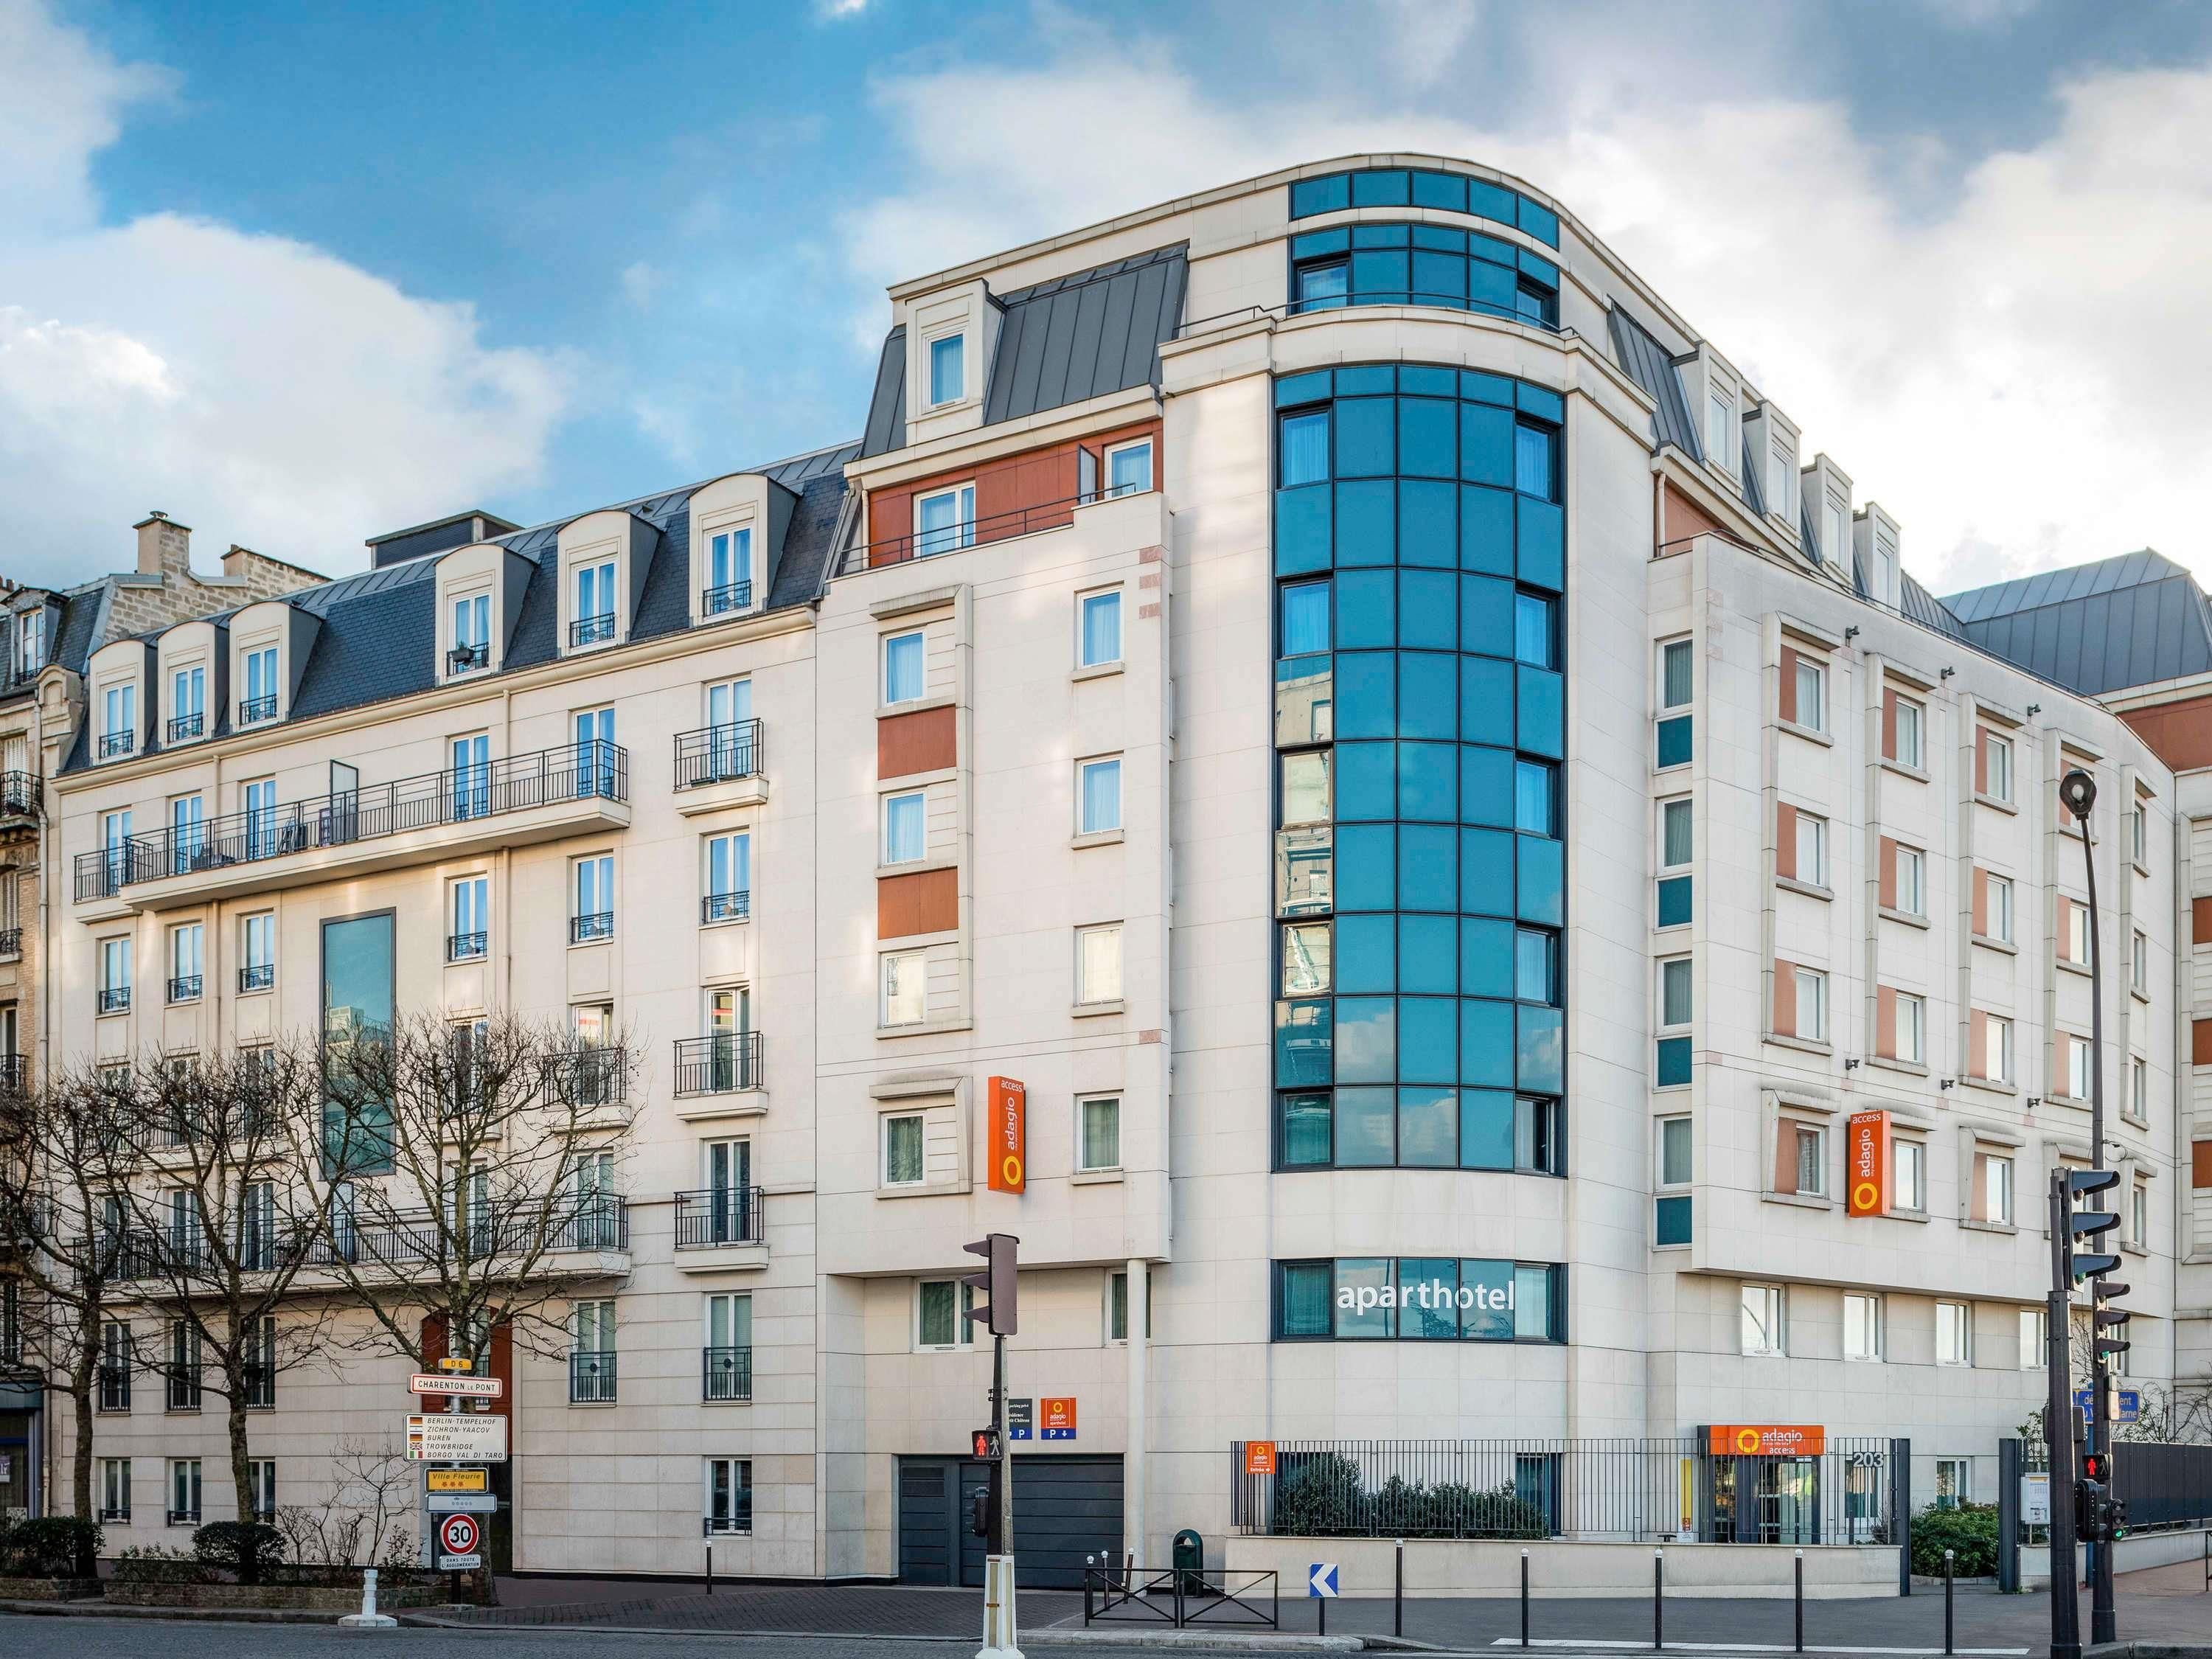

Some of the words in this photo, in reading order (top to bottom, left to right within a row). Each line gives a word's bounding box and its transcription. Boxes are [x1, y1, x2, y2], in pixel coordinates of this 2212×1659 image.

[1001, 1079, 1023, 1093] access
[1005, 1096, 1018, 1150] adagio
[1852, 1113, 1881, 1124] access
[1857, 1129, 1874, 1178] adagio
[1337, 1279, 1514, 1315] aparthotel
[418, 1380, 465, 1390] CHARENTON
[1018, 1429, 1025, 1439] P
[1049, 1429, 1056, 1439] P
[1761, 1427, 1803, 1444] adagio
[1769, 1447, 1795, 1455] access
[1853, 1452, 1884, 1467] 203
[450, 1526, 472, 1543] 30
